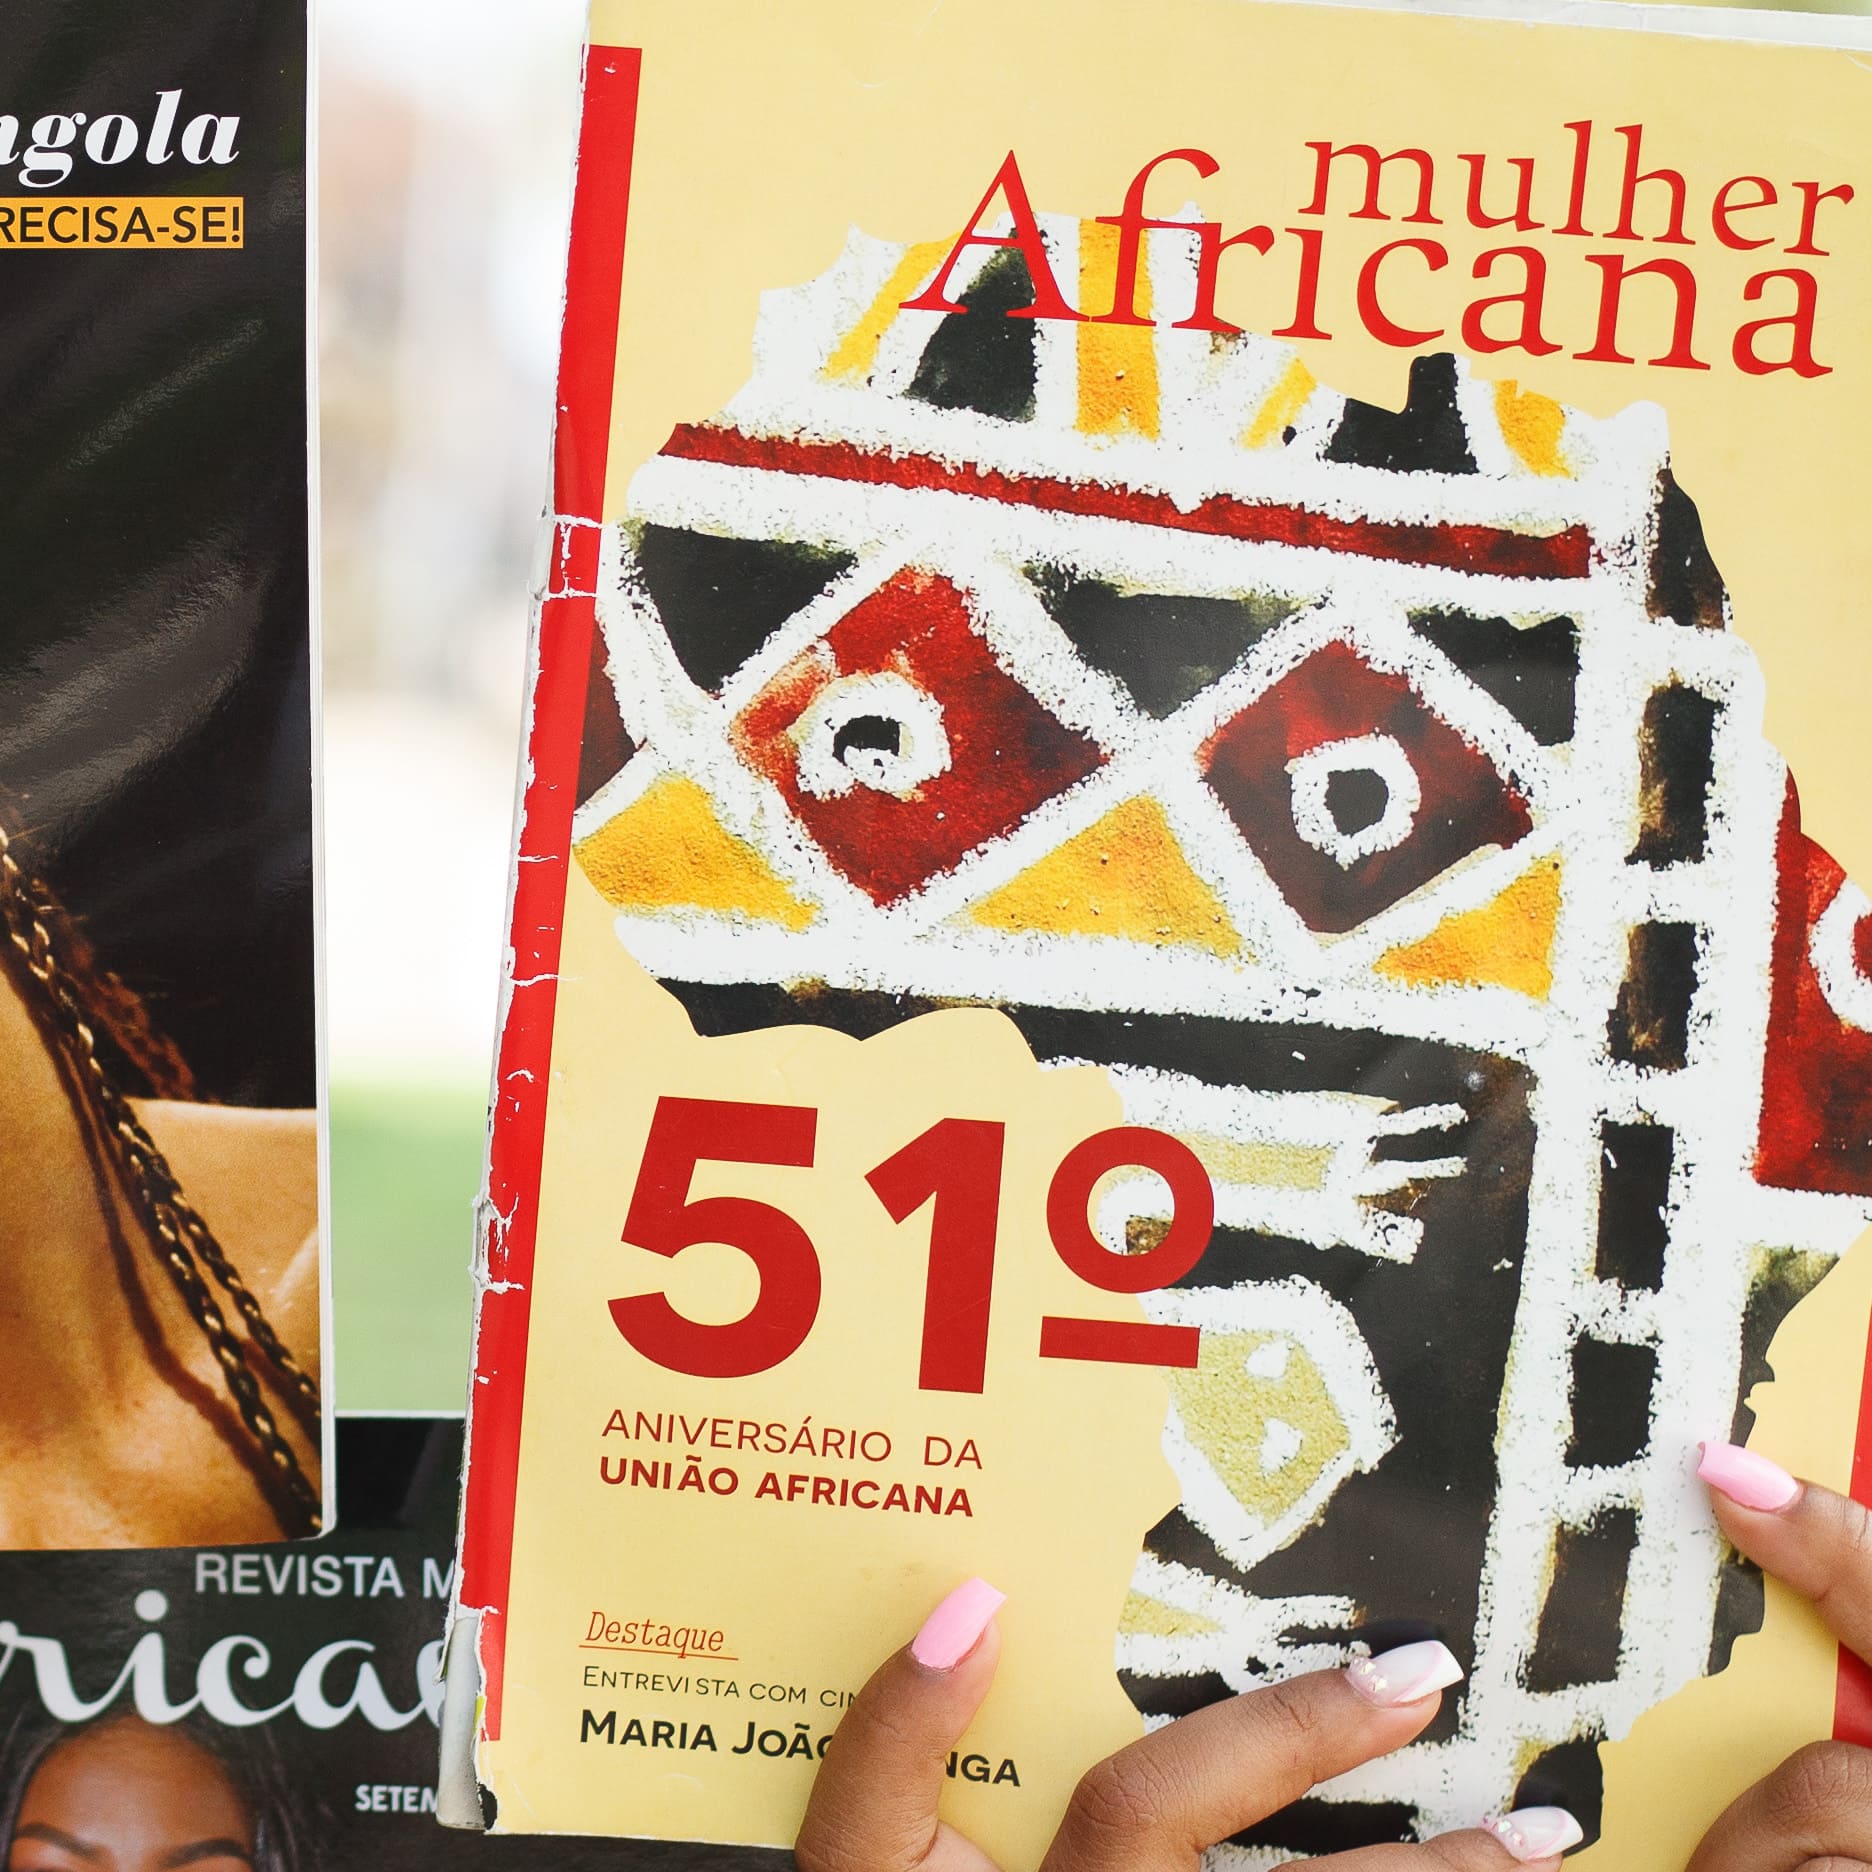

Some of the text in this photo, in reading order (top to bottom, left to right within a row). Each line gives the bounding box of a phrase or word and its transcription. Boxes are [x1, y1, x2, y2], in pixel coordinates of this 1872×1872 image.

[1297, 119, 1855, 257] mulher
[898, 147, 1834, 380] Africana
[601, 1410, 980, 1467] ANIVERSÁRIO DA
[601, 1455, 972, 1517] UNIÃO AFRICANA
[196, 1553, 405, 1598] REVISTA
[583, 1608, 726, 1660] Destaque
[578, 1706, 720, 1754] MARIA
